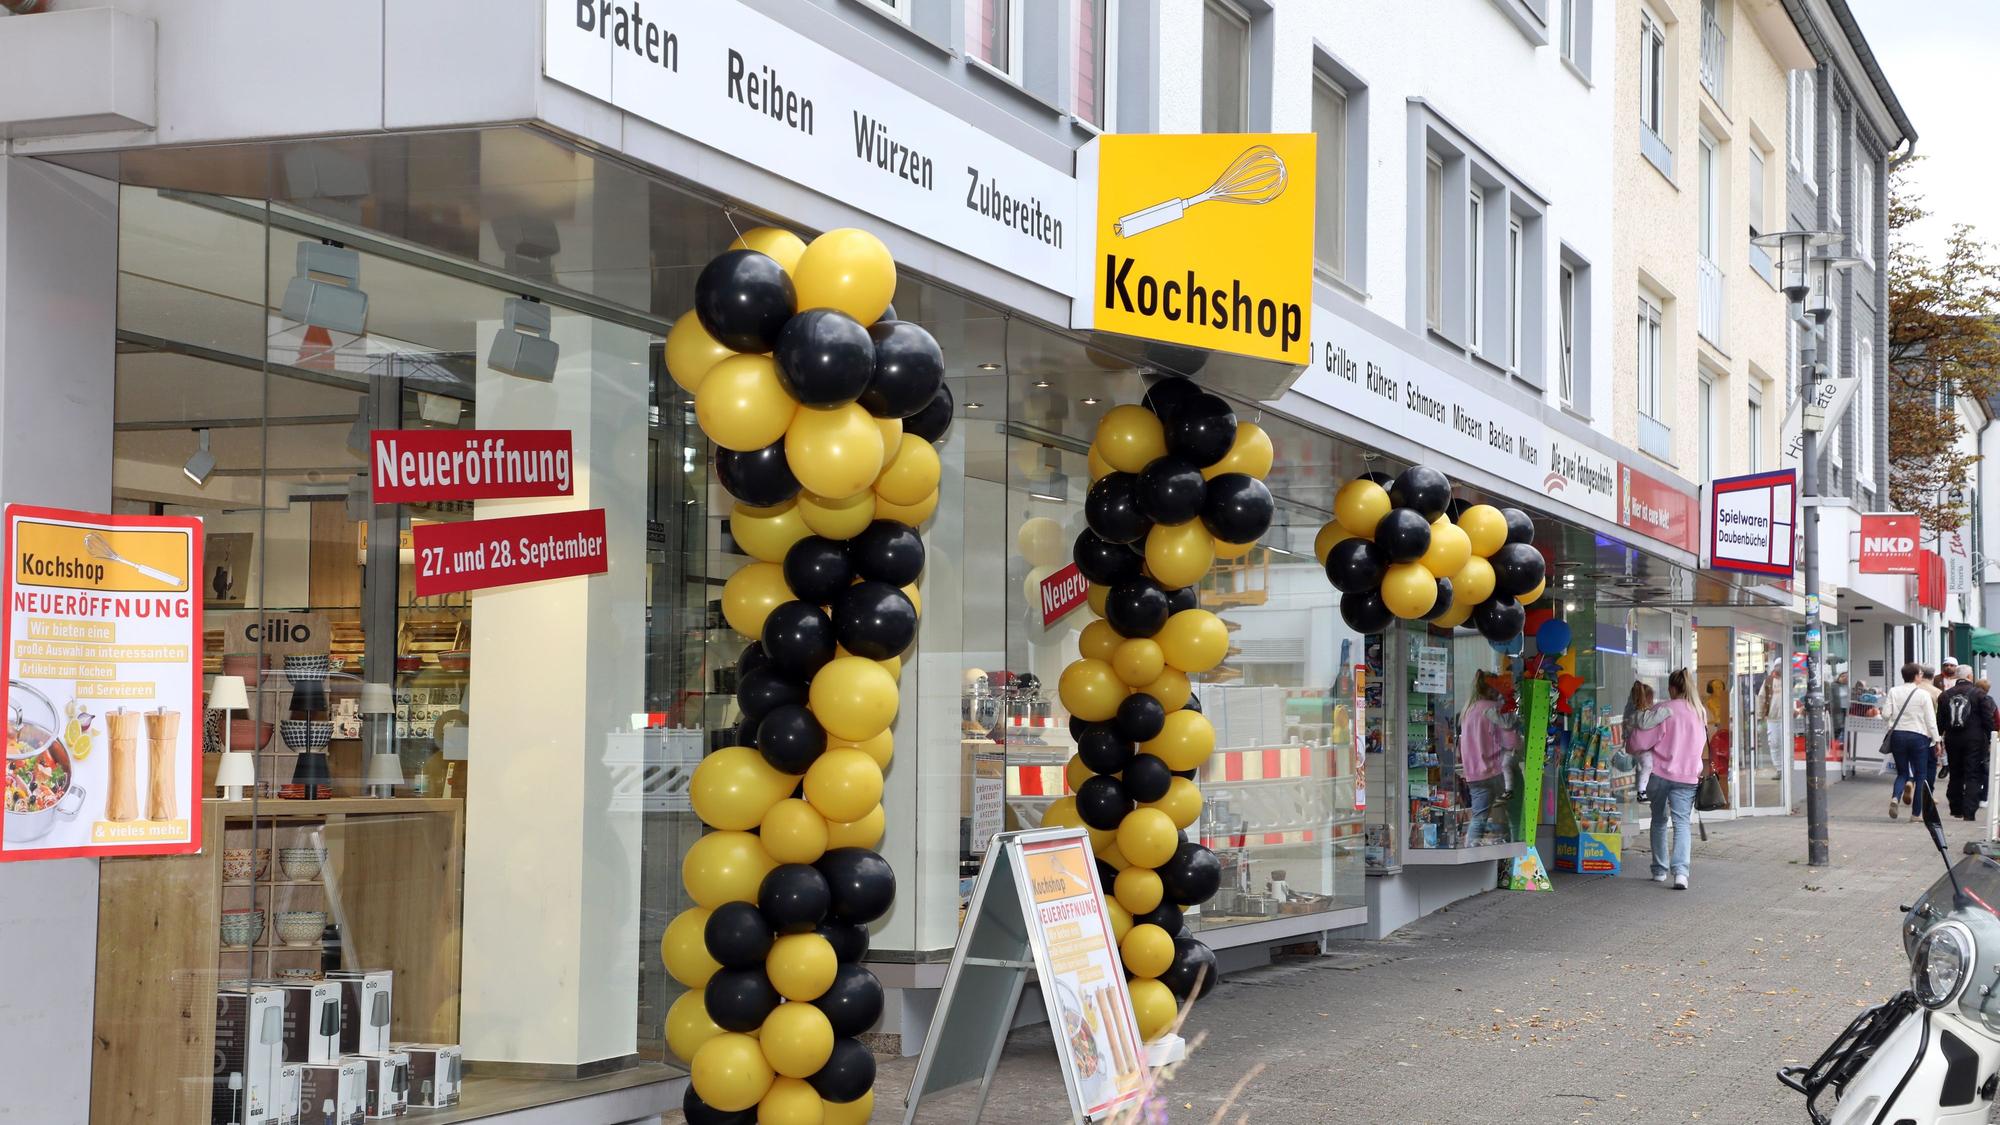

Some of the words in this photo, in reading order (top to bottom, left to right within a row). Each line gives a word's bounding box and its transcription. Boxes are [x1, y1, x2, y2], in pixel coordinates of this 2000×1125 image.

[728, 48, 814, 136] Reiben
[853, 110, 933, 190] Würzen
[967, 166, 1063, 249] Zubereiten
[1105, 254, 1301, 352] Kochshop
[1325, 341, 1358, 384] Grillen
[1366, 361, 1398, 403] Rühren
[1406, 381, 1446, 425] Schmoren
[1453, 404, 1483, 441] Mörsern
[1489, 421, 1513, 455] Backen
[1519, 435, 1538, 466] Mixen
[376, 438, 570, 491] Neueröffnung
[1551, 443, 1561, 474] Die
[1563, 452, 1577, 480] zwei
[1577, 455, 1613, 497] Fachgeschäfte
[1719, 508, 1768, 528] Spielwaren
[1719, 530, 1768, 547] Daubenbüchel
[1864, 537, 1914, 552] NKD
[421, 547, 450, 577] 27.
[453, 543, 485, 573] und
[490, 541, 516, 569] 28.
[519, 533, 602, 568] September
[23, 553, 104, 584] Kochshop
[14, 591, 189, 618] NEUERÖFFNUNG
[1042, 572, 1090, 615] Neuerö
[30, 620, 50, 636] Wir
[52, 622, 85, 638] bieten
[87, 626, 110, 639] eine
[245, 618, 311, 643] cilio
[17, 644, 43, 657] große
[46, 644, 83, 658] Auswahl
[85, 649, 96, 658] an
[98, 646, 184, 659] interessanten
[22, 663, 56, 675] Artikeln
[58, 666, 77, 676] zum
[79, 664, 113, 678] Kochen
[78, 684, 94, 695] und
[97, 683, 152, 696] Servieren
[95, 825, 105, 837] &
[110, 824, 145, 837] vieles
[149, 823, 184, 836] mehr.
[1032, 875, 1066, 896] Kochshop
[315, 988, 326, 997] cilio
[366, 981, 377, 989] cilio
[302, 1069, 316, 1114] cilio
